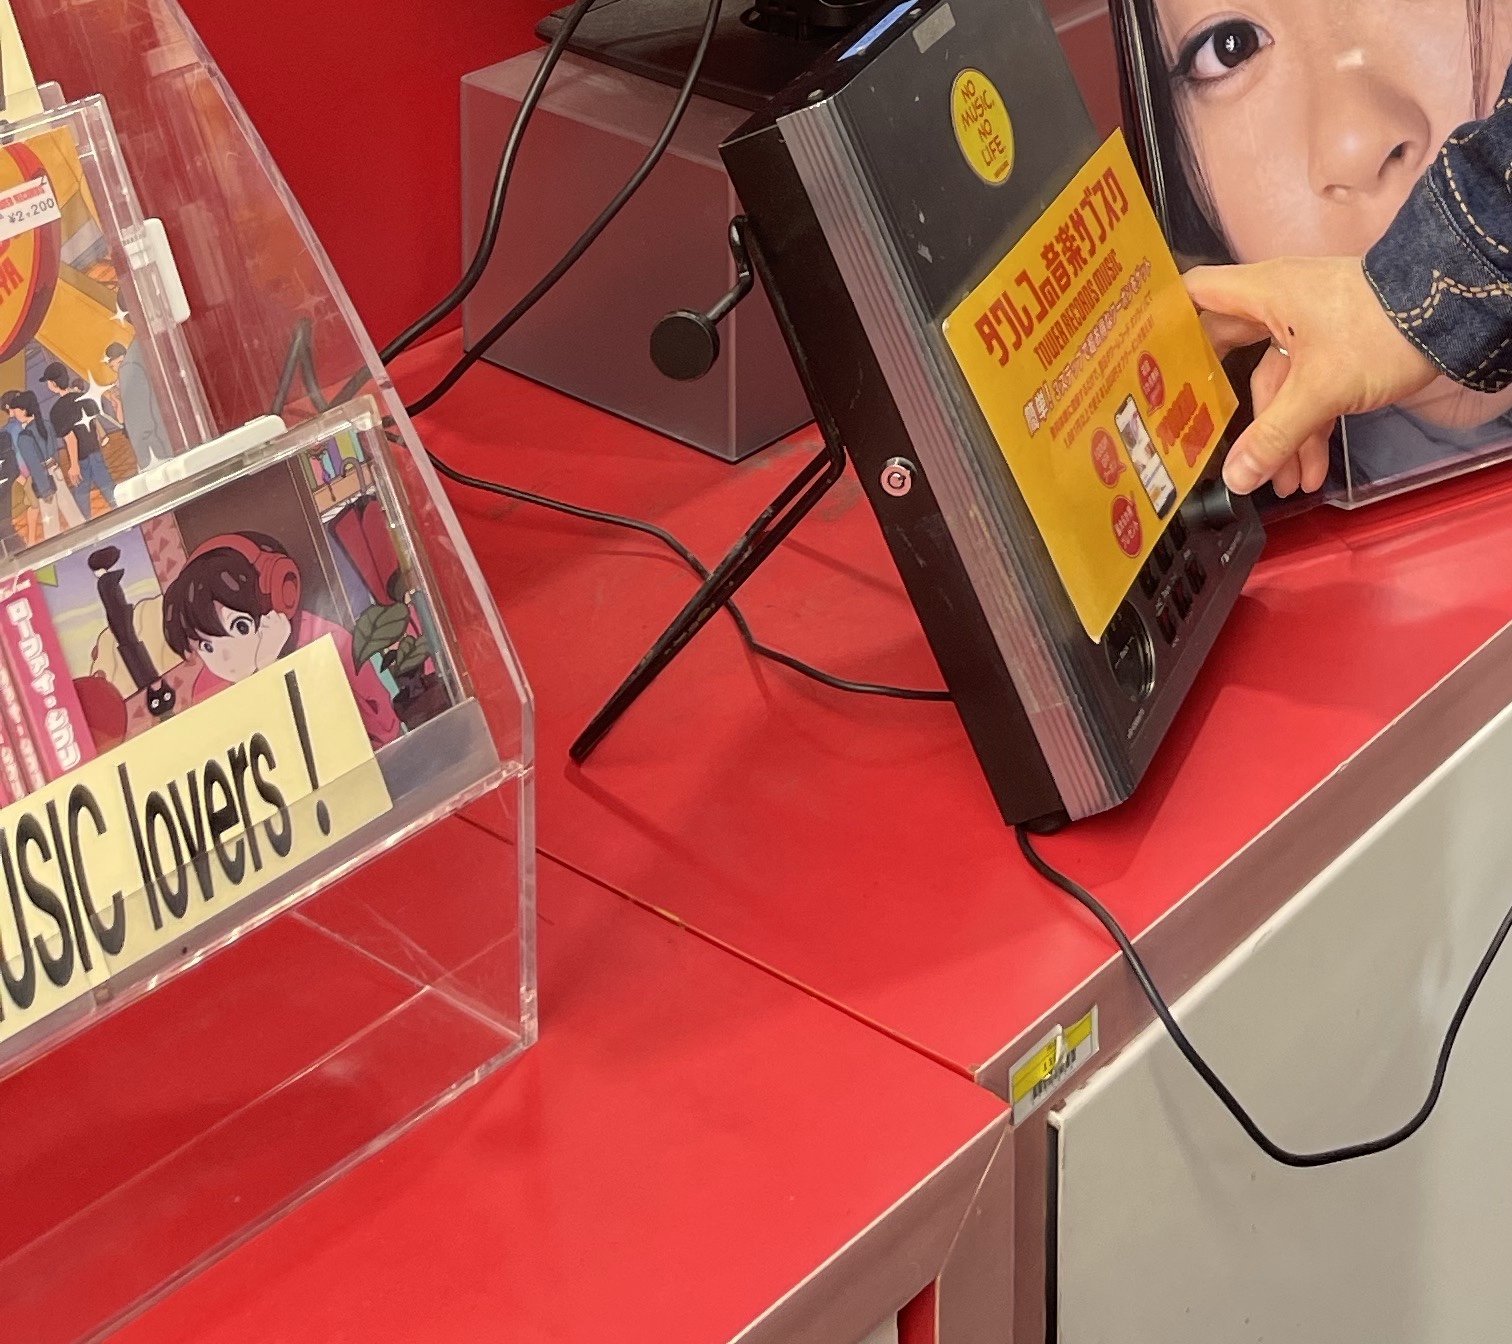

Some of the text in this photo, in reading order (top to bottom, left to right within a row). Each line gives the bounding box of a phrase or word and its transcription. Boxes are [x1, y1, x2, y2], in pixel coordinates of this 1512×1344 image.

[960, 79, 976, 103] NO
[977, 118, 993, 142] NO
[974, 166, 1129, 368] タワレコの音楽サブスク
[1033, 248, 1123, 371] TOWER RECORDS MUSIC
[0, 784, 127, 1022] USIC
[117, 732, 292, 931] lovers
[283, 670, 332, 837] !
